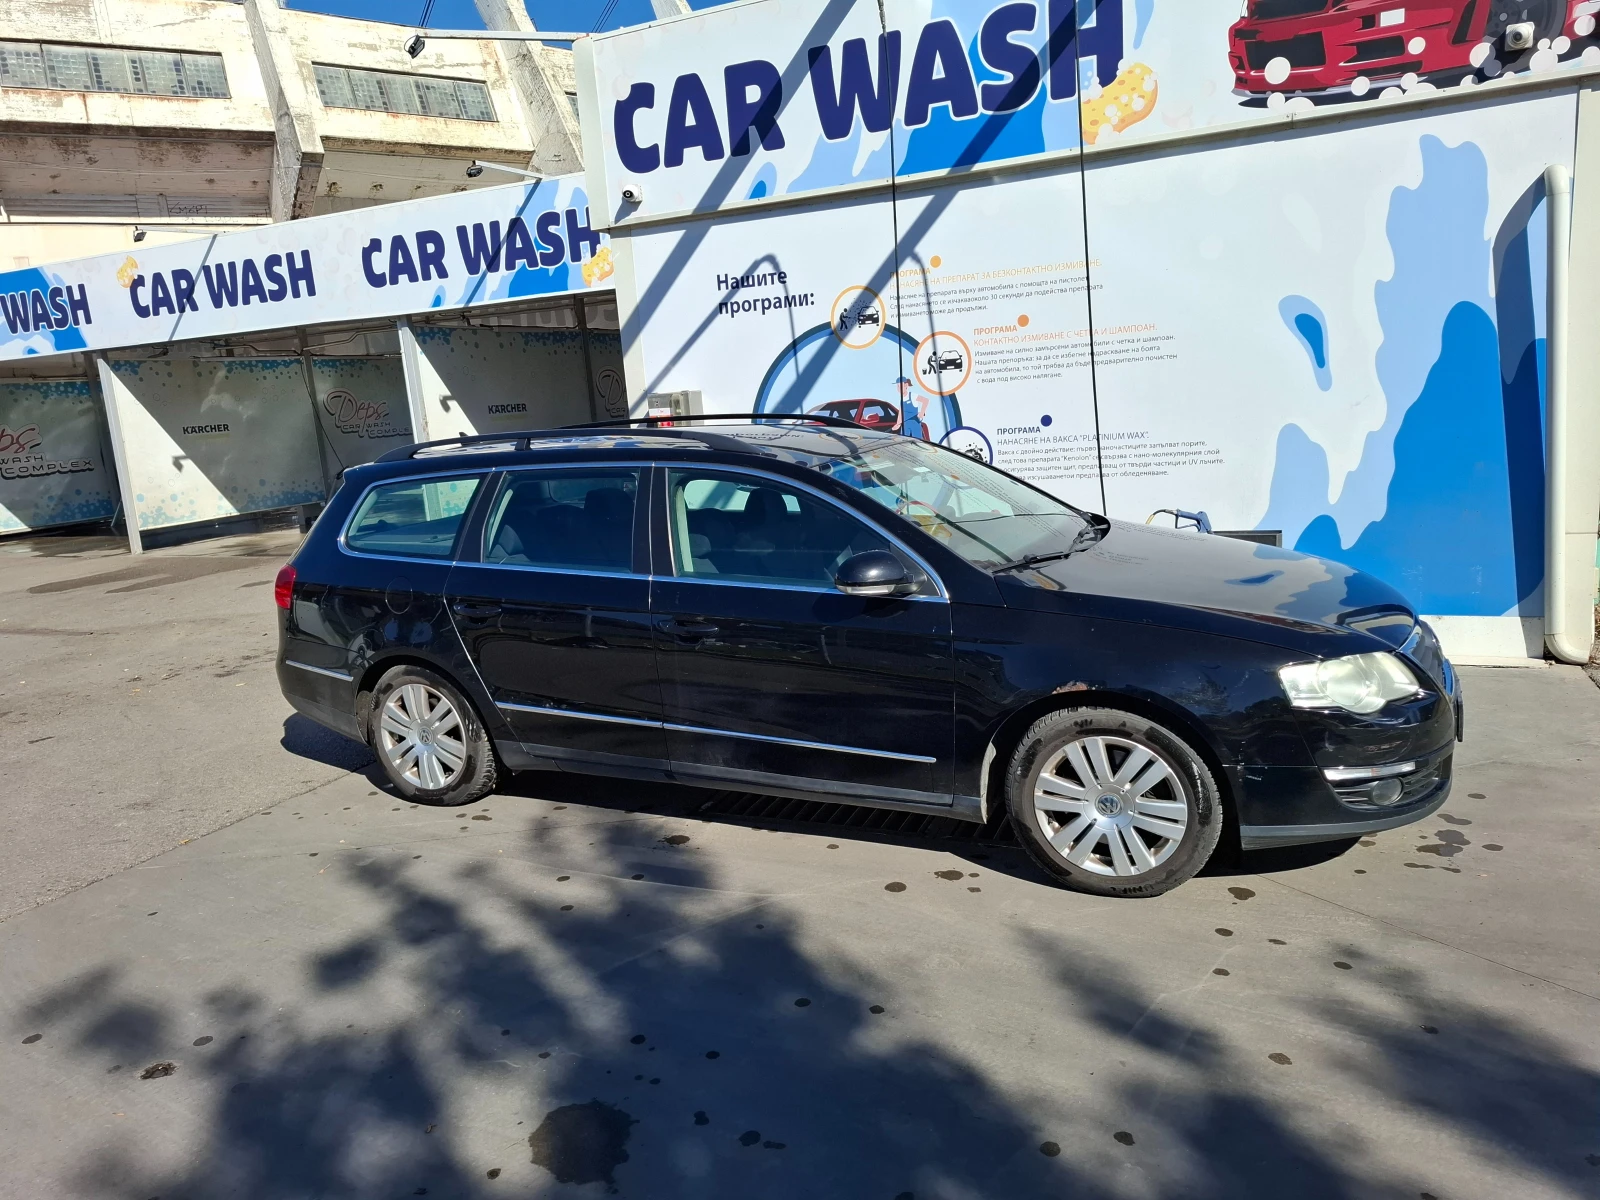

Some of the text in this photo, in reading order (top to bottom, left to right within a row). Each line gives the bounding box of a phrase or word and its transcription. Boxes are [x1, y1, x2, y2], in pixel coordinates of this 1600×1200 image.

[614, 0, 1123, 173] CAR WASH
[362, 206, 600, 288] CAR WASH
[890, 268, 931, 279] ПОГРАМА
[890, 279, 928, 290] ННАСЯНЕ
[943, 272, 980, 284] ПРЕПАРАТ
[982, 271, 990, 279] ЗА
[992, 264, 1053, 278] БЕЗКОНТАКТНО
[1055, 259, 1103, 270] ИЗМИВНЕ.
[130, 248, 316, 318] CAR WASH
[716, 270, 788, 291] Нашите
[959, 286, 976, 295] върху
[978, 284, 1014, 292] автомобила
[999, 292, 1024, 300] секунди
[1034, 287, 1067, 296] подейства
[0, 283, 92, 334] WASH
[718, 292, 816, 318] програми:
[974, 325, 1018, 335] ПРОГРАМА
[974, 336, 1019, 346] КОНТАКТНО
[1021, 332, 1064, 342] ИЗМИВАНЕ
[1074, 329, 1099, 337] ЧЕТА
[1110, 323, 1158, 334] ШАМПОАН.
[1035, 344, 1069, 352] замърсени
[999, 356, 1035, 365] препоръка:
[984, 366, 1021, 375] автомобила,
[1043, 362, 1064, 370] трябва
[327, 390, 386, 432] Deps
[488, 403, 527, 415] KÄRCHER
[182, 423, 230, 435] KÄRCHER
[997, 426, 1041, 435] ПРОГРАМА
[998, 437, 1038, 446] НАНАСЯНЕ
[1053, 435, 1078, 443] ВАКСА
[5, 460, 92, 474] COMPLEX
[1127, 461, 1152, 469] твърди
